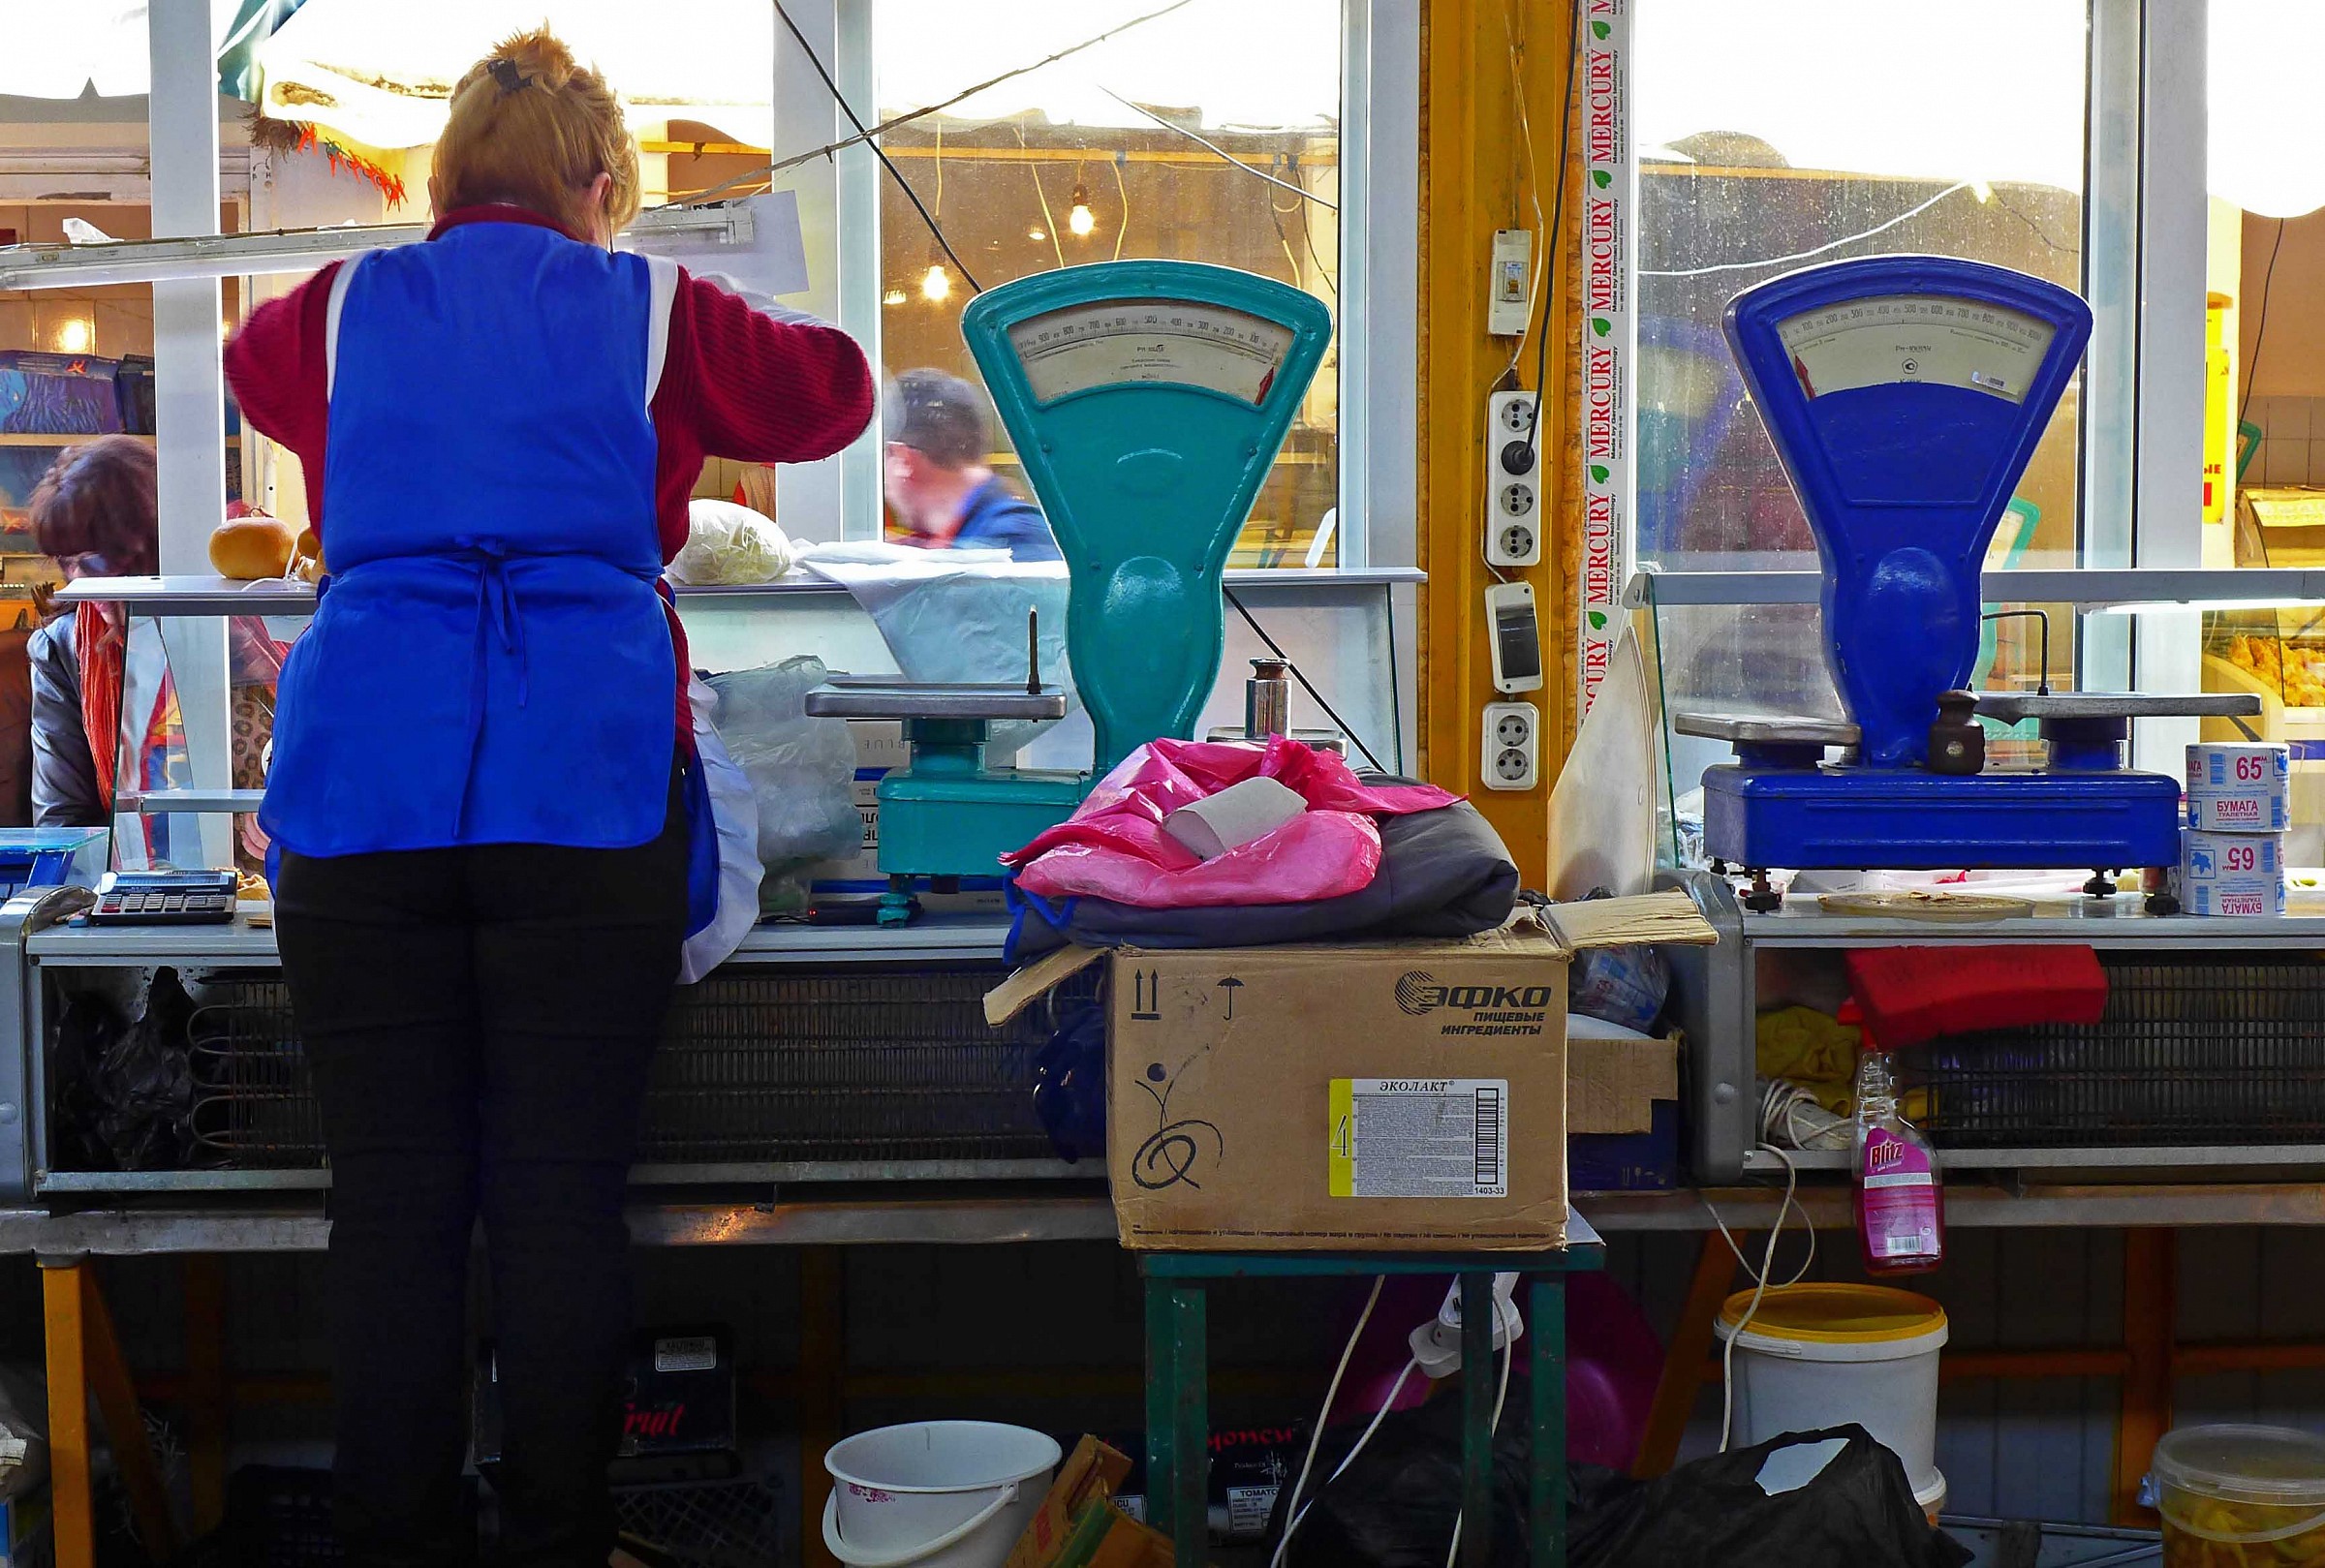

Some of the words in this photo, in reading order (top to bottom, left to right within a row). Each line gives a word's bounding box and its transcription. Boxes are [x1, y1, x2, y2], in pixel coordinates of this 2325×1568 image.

[1591, 48, 1612, 164] MERCURY
[1591, 198, 1612, 312] MERCURY
[1590, 345, 1611, 459] MERCURY
[1587, 492, 1609, 604] MERCURY
[2216, 800, 2259, 812] БУМАГА
[2221, 903, 2262, 914] БУМАГА
[1418, 986, 1552, 1010] ЭФКО
[1441, 1025, 1542, 1036] ИНГРЕДИЕНТЫ
[1473, 1011, 1545, 1024] ПИЩЕВЫЕ
[1330, 1115, 1350, 1158] 4
